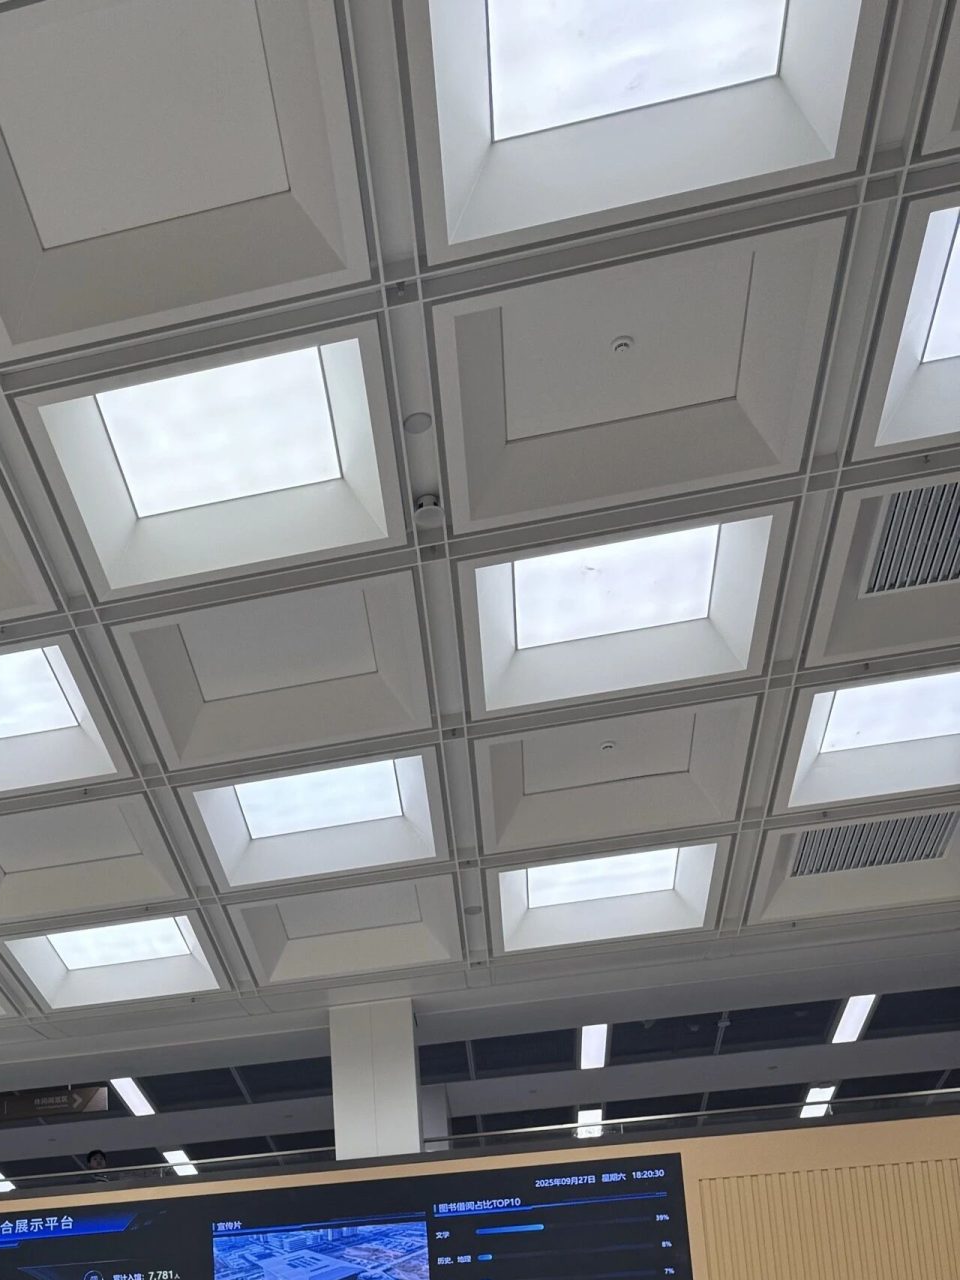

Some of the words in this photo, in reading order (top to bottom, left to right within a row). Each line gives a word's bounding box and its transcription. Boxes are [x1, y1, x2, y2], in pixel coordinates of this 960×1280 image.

[535, 1174, 596, 1188] 2025年09月27日
[602, 1172, 626, 1183] 星期六
[632, 1169, 664, 1180] 18:20:30
